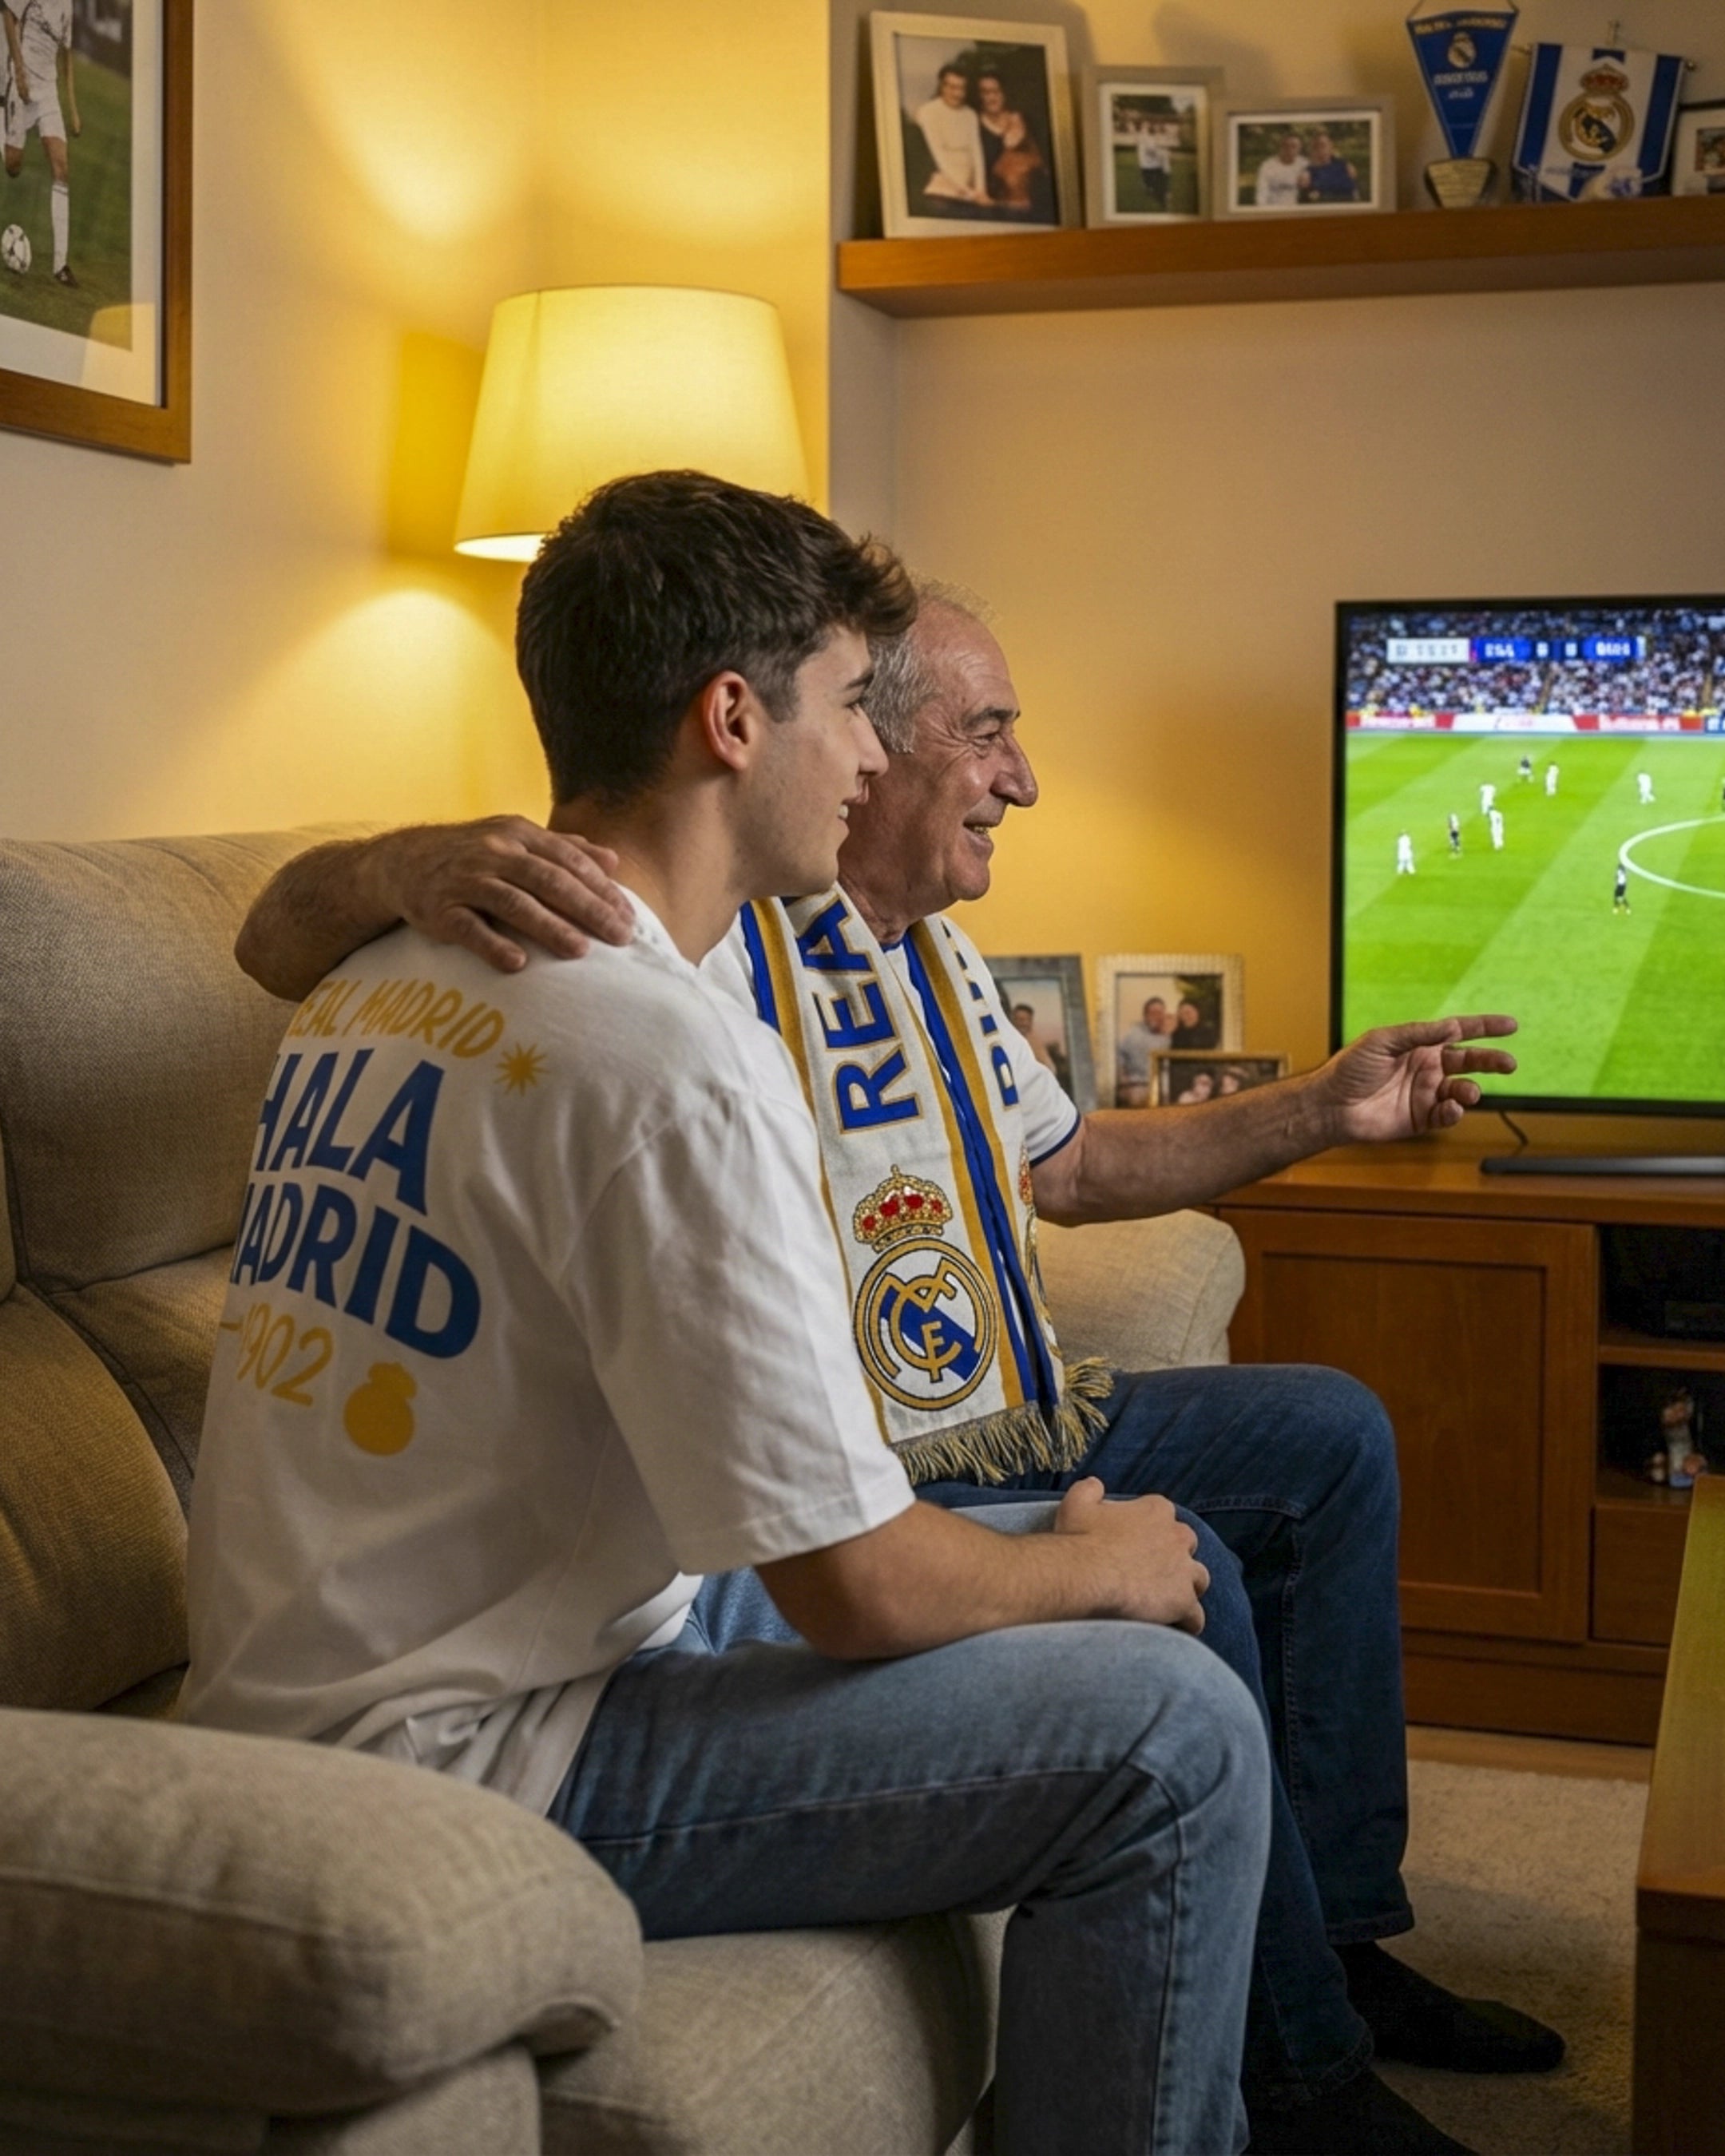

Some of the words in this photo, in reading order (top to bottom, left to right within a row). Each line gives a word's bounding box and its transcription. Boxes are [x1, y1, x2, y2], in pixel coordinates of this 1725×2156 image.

[288, 979, 362, 1037] EAL
[341, 979, 505, 1058] MADRID
[797, 894, 924, 1134] REA
